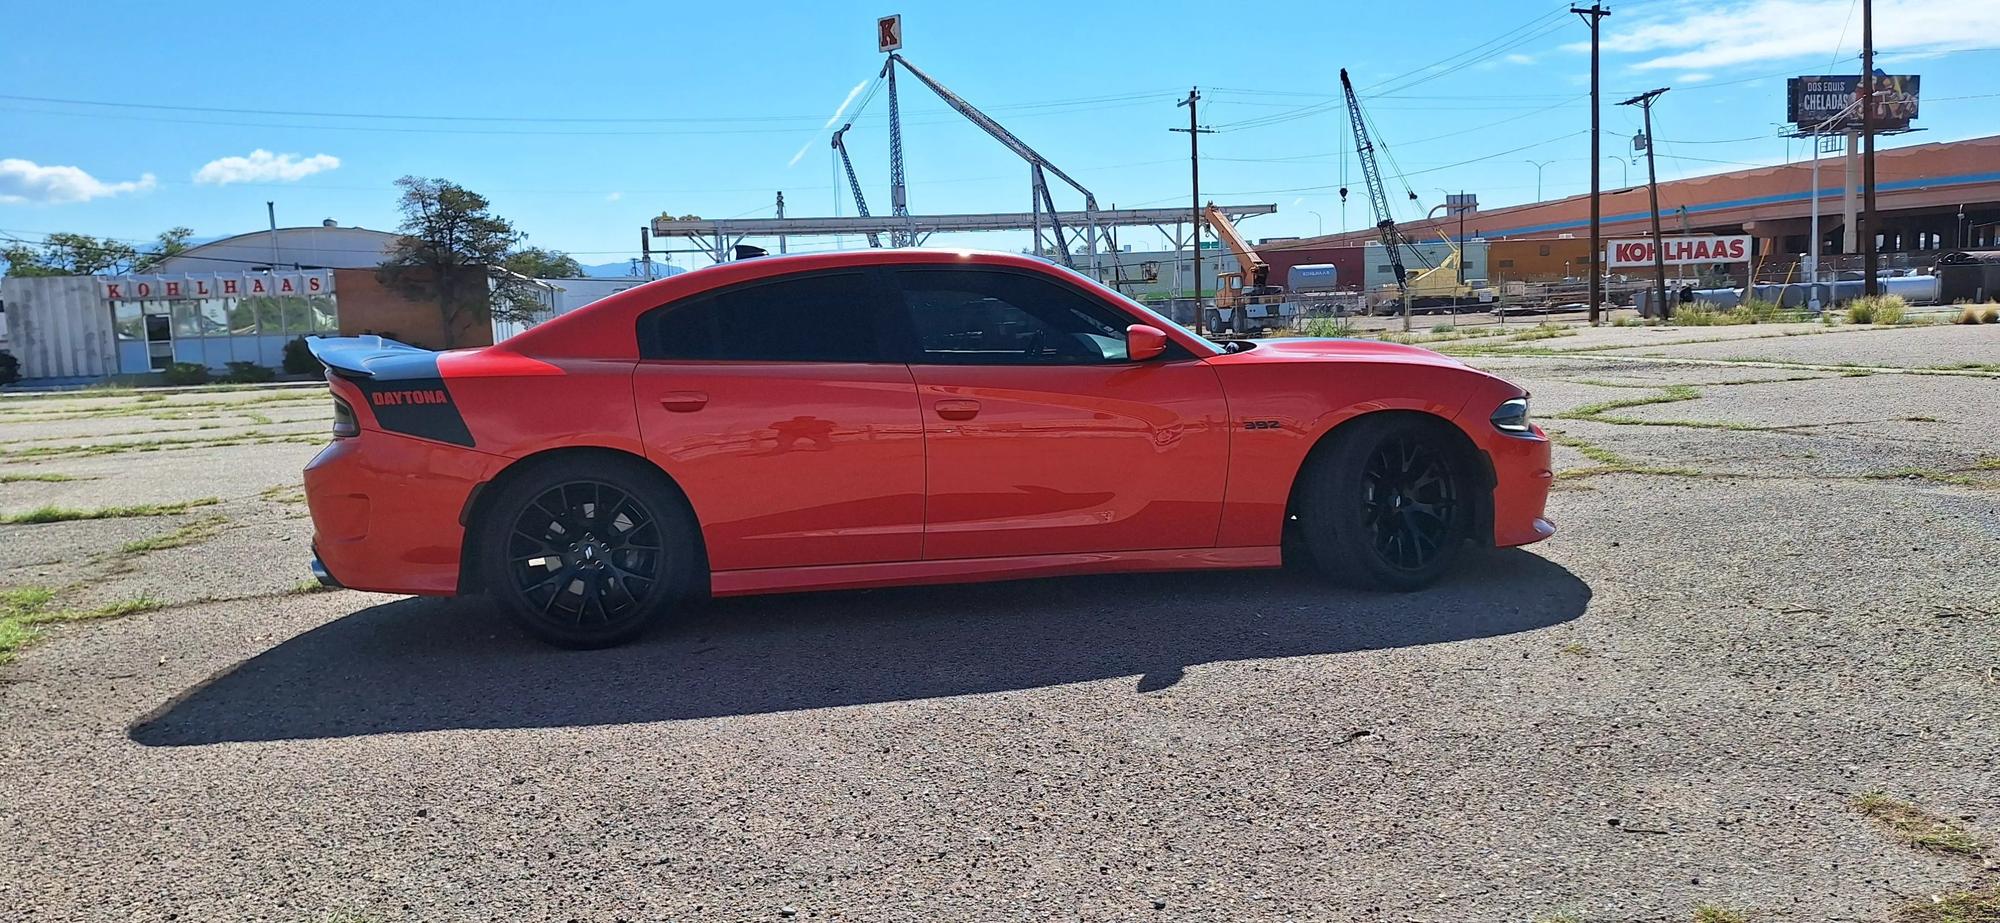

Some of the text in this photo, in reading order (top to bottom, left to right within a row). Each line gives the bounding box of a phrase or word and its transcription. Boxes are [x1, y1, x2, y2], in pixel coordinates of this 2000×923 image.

[880, 18, 898, 47] K
[1807, 81, 1845, 92] DOS EQUIS
[1804, 93, 1849, 111] CHELADAS
[1616, 239, 1744, 262] KOHLHAAS
[106, 277, 320, 299] KOHLHAAS
[372, 390, 448, 405] DAYTONA
[1243, 420, 1281, 430] 392
